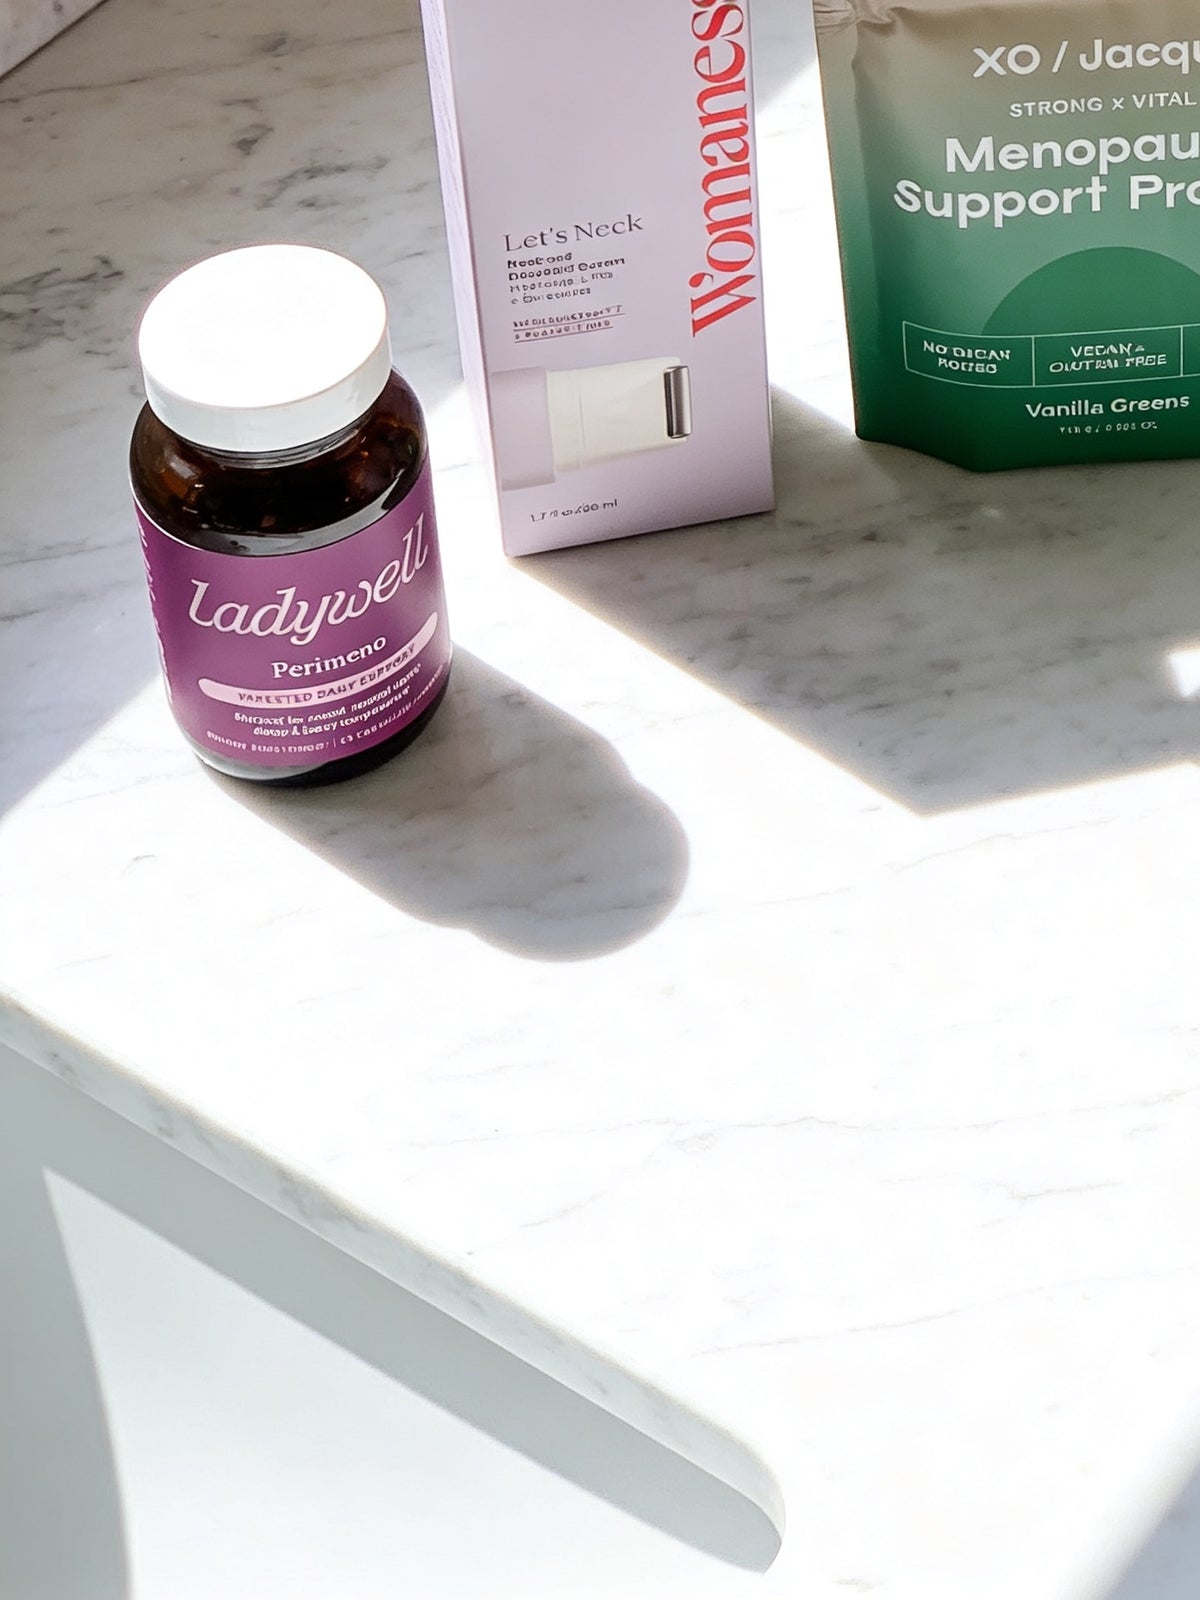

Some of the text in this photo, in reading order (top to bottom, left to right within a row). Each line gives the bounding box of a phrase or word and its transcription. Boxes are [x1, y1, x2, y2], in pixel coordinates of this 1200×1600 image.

[973, 44, 1041, 78] XO
[1009, 96, 1103, 118] STRONG
[1131, 91, 1198, 111] VITAL
[893, 176, 1107, 229] Support
[503, 214, 643, 251] Let's Neck
[1025, 395, 1191, 418] Vanilla Greens
[271, 635, 387, 679] Perimeno
